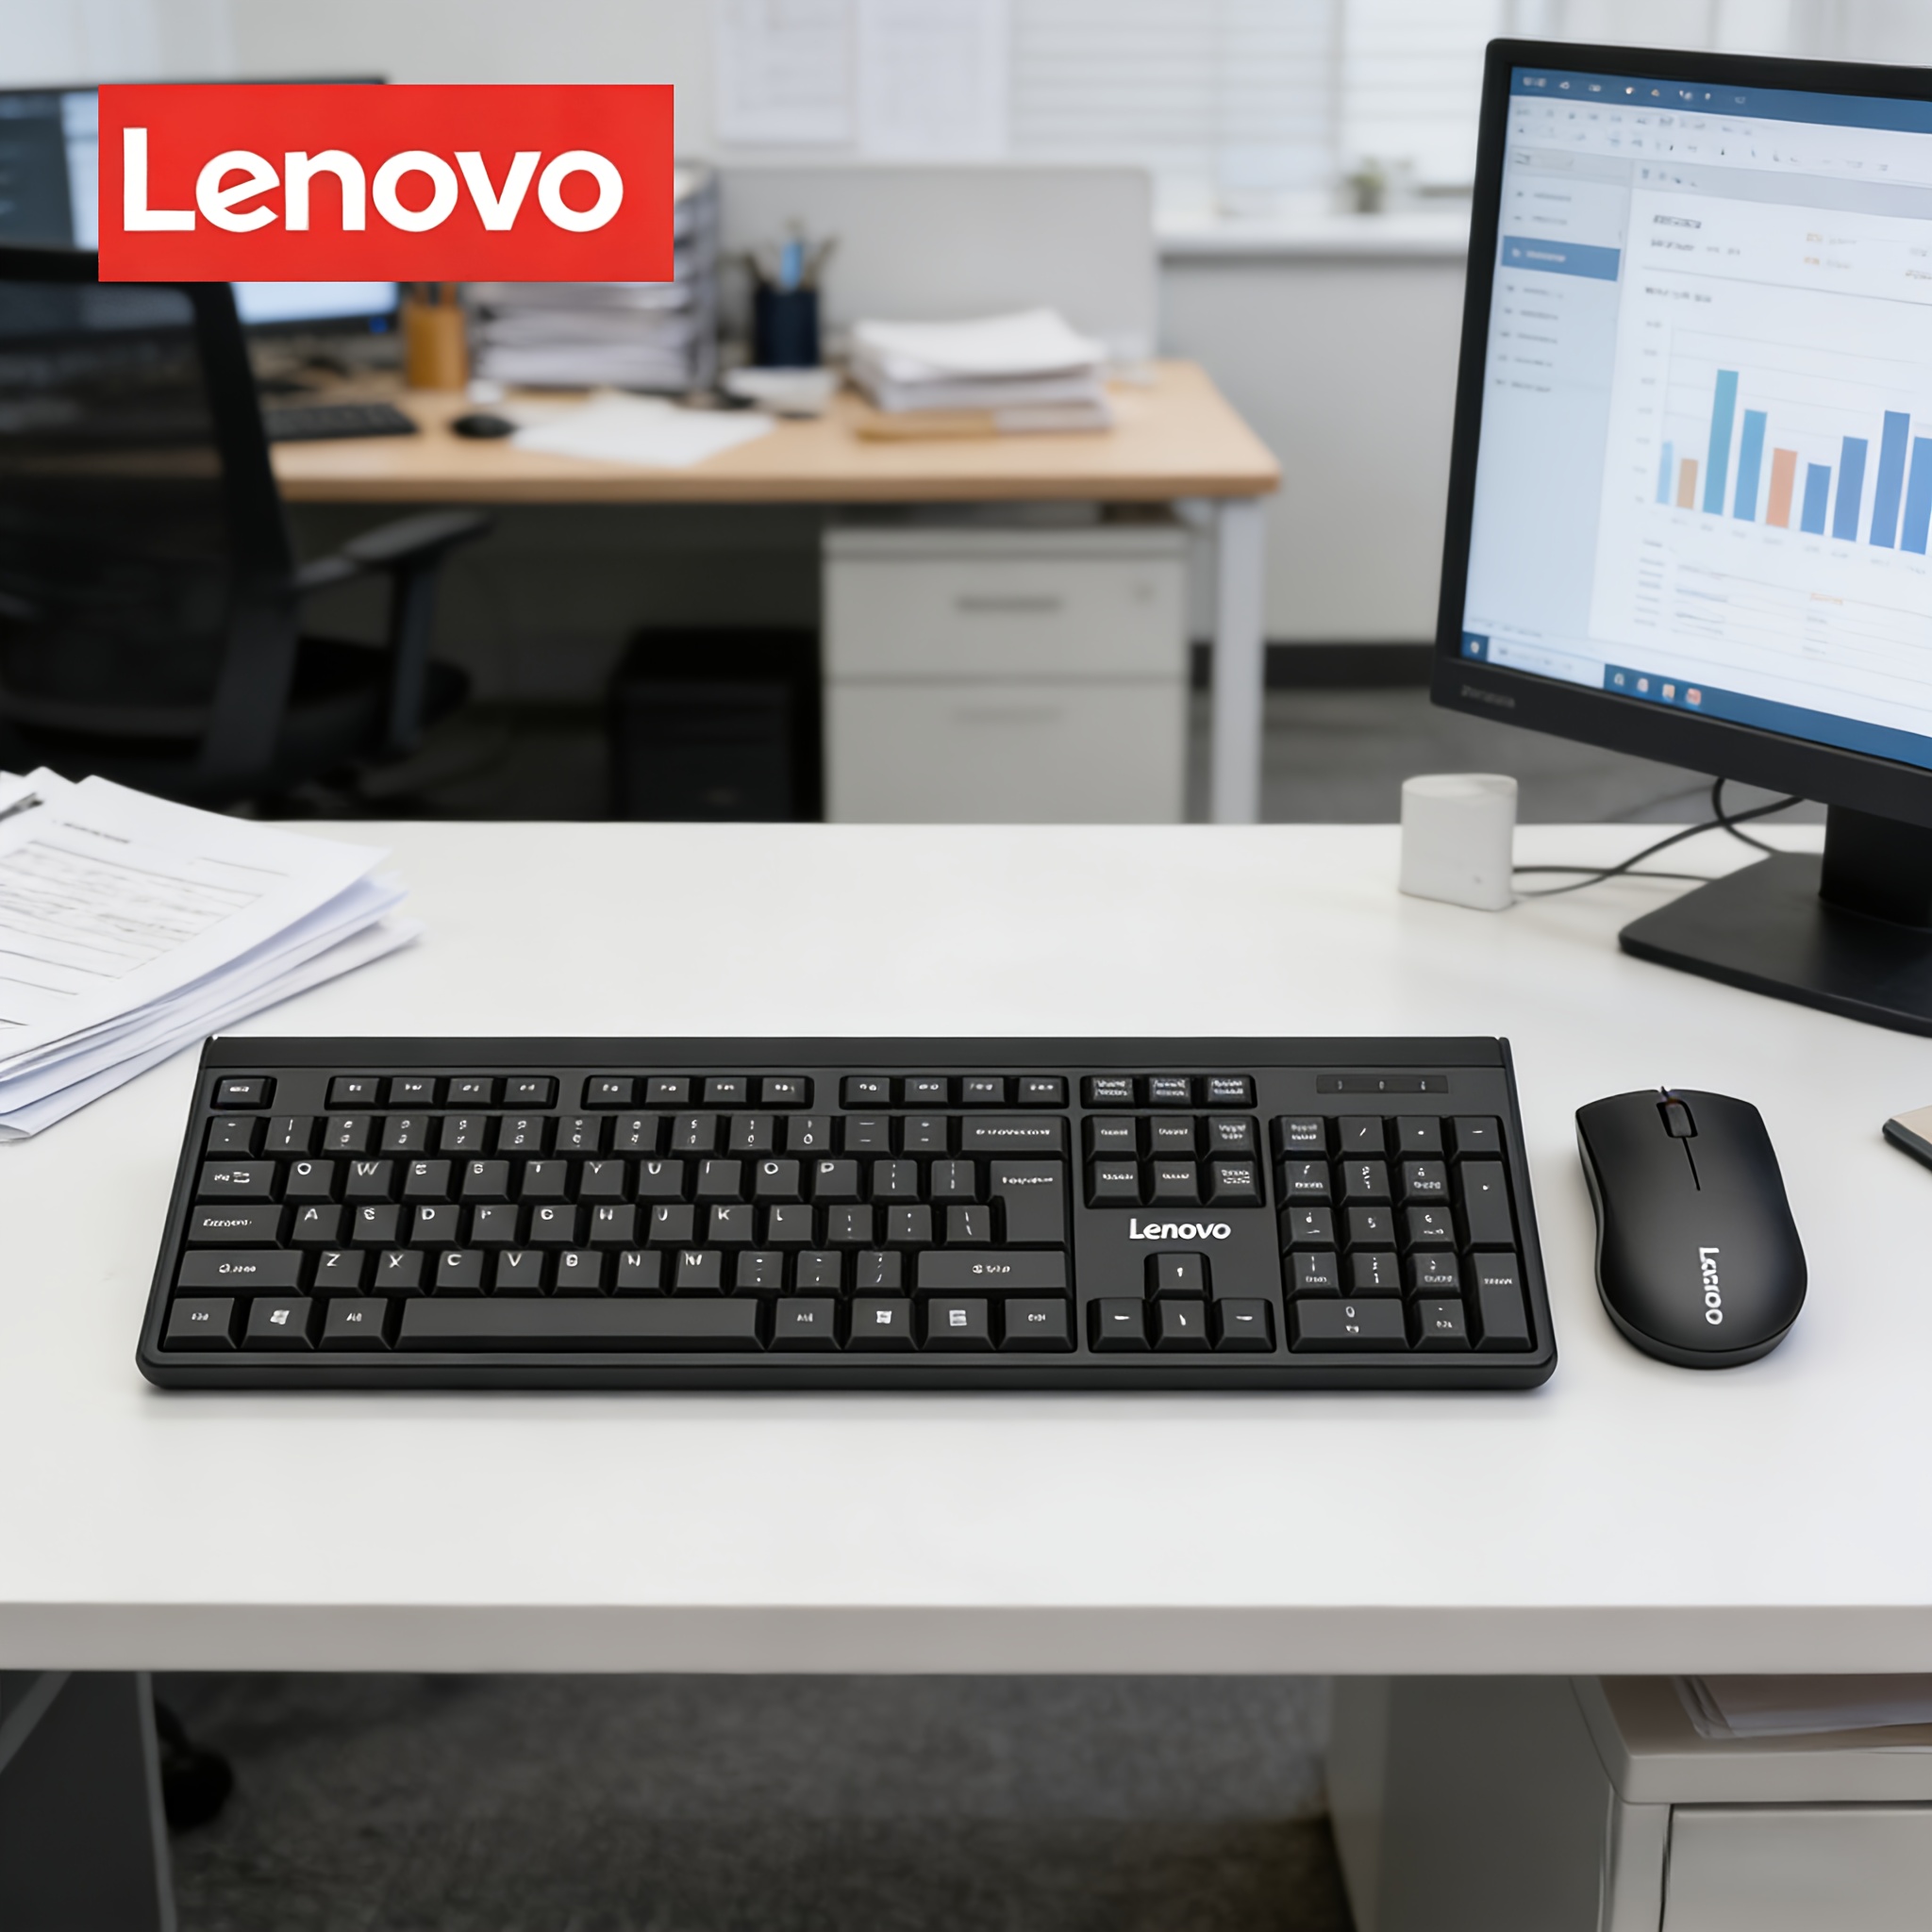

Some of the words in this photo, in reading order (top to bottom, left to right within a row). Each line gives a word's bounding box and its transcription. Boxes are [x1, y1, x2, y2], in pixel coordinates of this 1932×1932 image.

[357, 1160, 380, 1176] W
[589, 1160, 604, 1174] Y
[647, 1161, 662, 1175] U
[763, 1161, 779, 1175] O
[820, 1161, 835, 1174] P
[304, 1208, 319, 1222] A
[421, 1207, 436, 1221] D
[717, 1207, 731, 1221] K
[775, 1208, 784, 1222] L
[1129, 1217, 1231, 1241] Lenovo
[325, 1252, 341, 1267] Z
[389, 1253, 405, 1269] X
[446, 1253, 462, 1267] C
[507, 1252, 523, 1268] V
